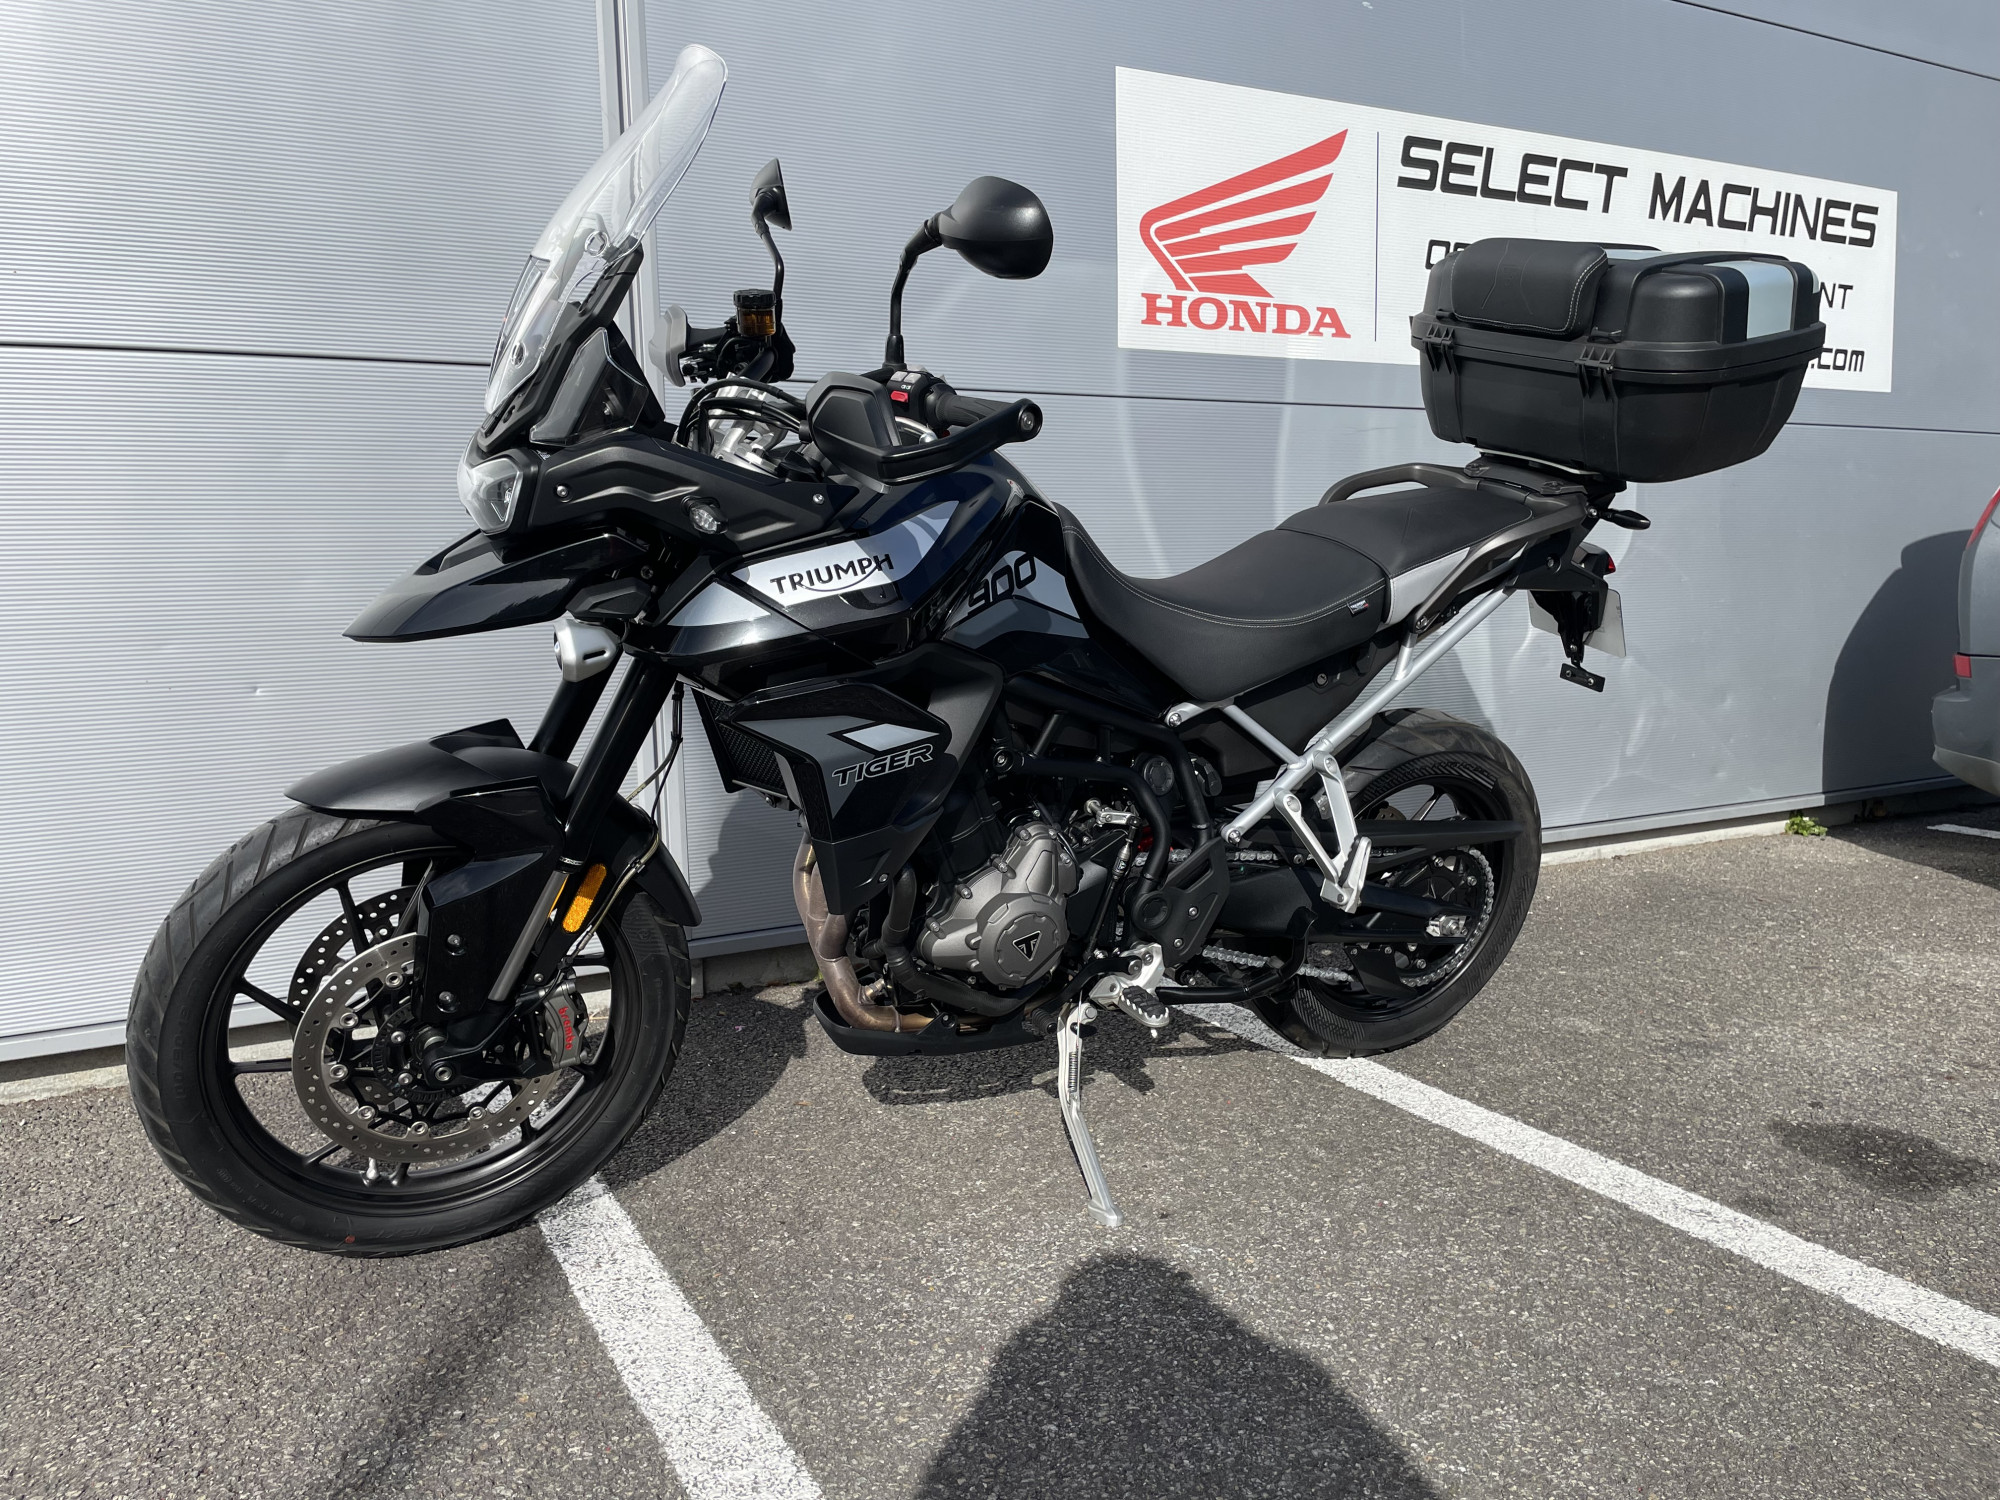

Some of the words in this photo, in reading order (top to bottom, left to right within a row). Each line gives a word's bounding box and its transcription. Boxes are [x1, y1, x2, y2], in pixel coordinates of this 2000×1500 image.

[1397, 135, 1628, 214] SELECT
[1648, 172, 1879, 248] MACHINES
[1141, 292, 1351, 339] HONDA
[770, 553, 895, 594] TRIUMPH
[967, 552, 1037, 615] 900
[831, 743, 934, 787] TIGER
[558, 1006, 576, 1051] brembo
